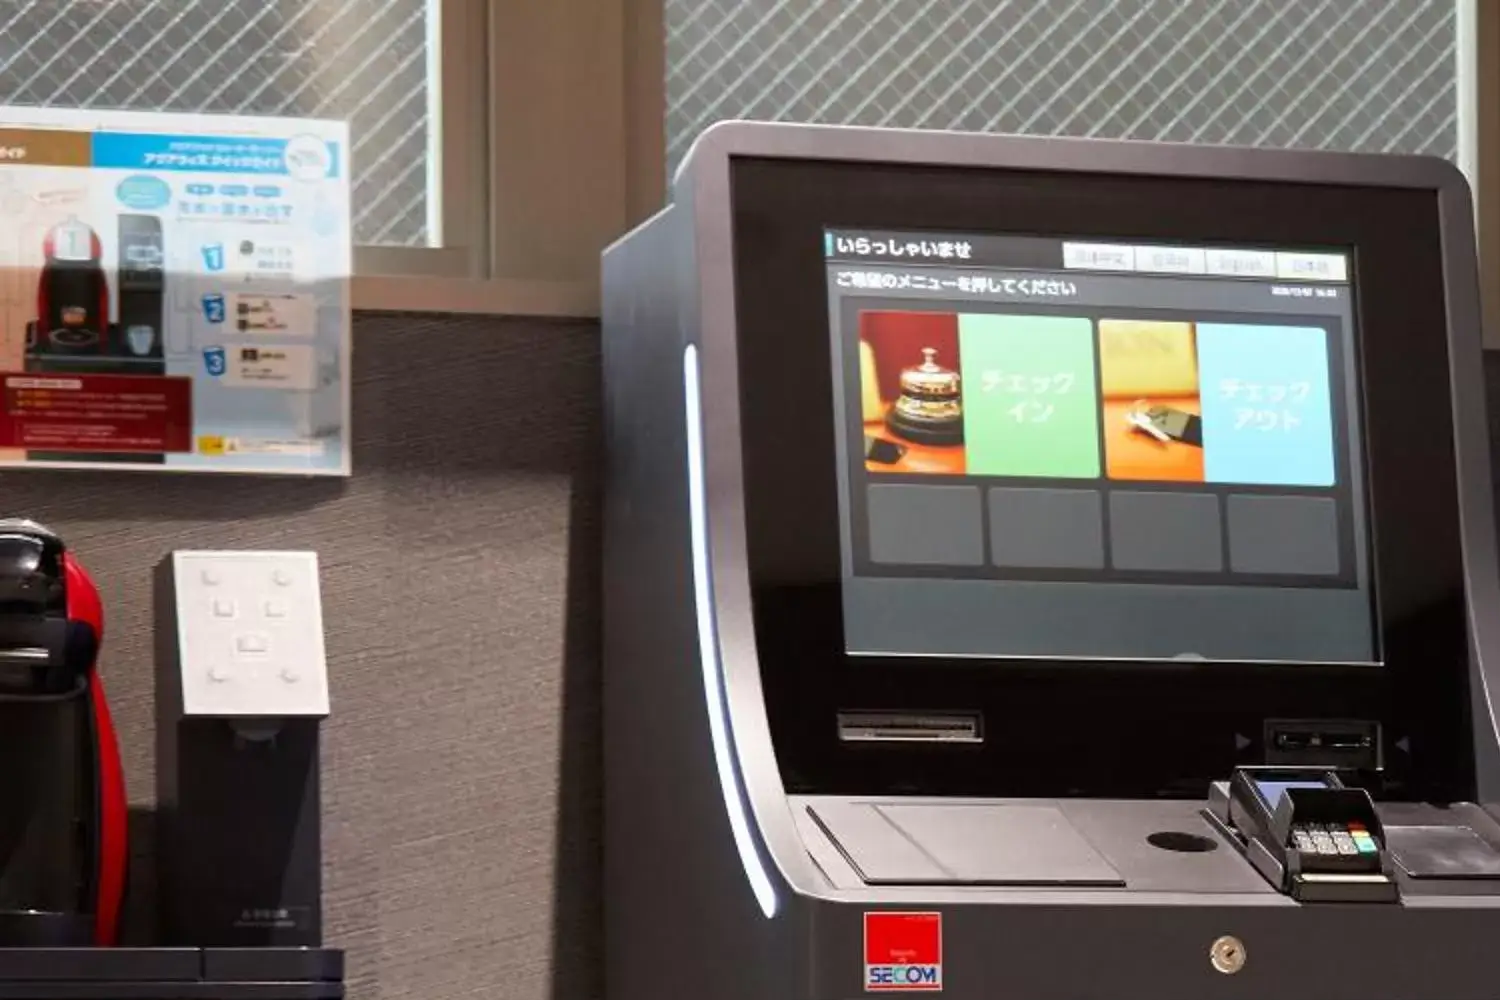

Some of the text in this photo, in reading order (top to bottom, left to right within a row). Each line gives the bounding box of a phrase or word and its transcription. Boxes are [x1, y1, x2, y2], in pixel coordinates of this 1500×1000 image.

[836, 237, 972, 259] いらっしゃいませ
[836, 270, 1077, 297] ご希望のメニューを押してください
[980, 369, 1076, 396] チェック
[1218, 377, 1312, 403] チェック
[1005, 400, 1056, 424] イン
[1232, 405, 1302, 434] アウト
[869, 966, 937, 983] SECOM
